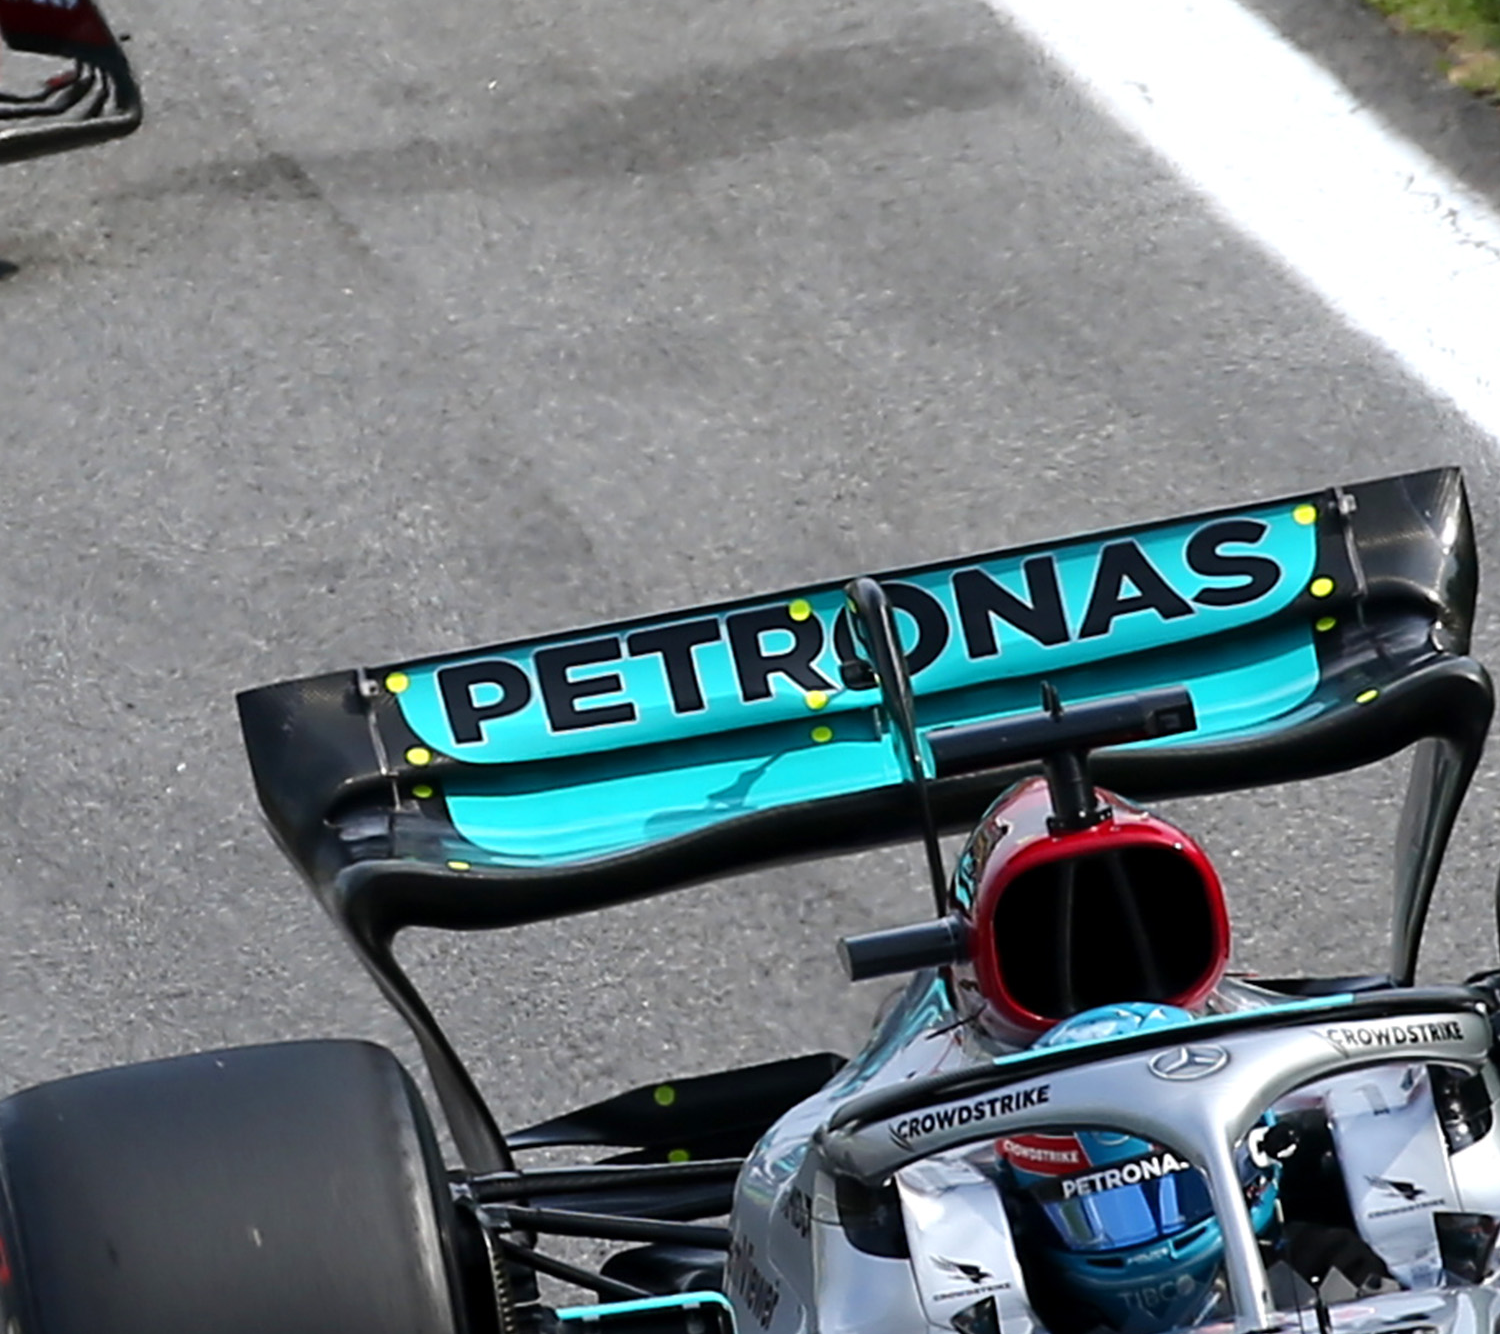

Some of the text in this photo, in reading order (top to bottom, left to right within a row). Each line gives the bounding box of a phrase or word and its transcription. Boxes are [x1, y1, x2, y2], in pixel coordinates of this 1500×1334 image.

[436, 517, 1286, 749] PETRONAS
[1327, 1021, 1464, 1046] CROWDSTRIKE
[890, 1084, 1051, 1149] CROWDSTRIKE
[1061, 1153, 1191, 1200] PETRONA
